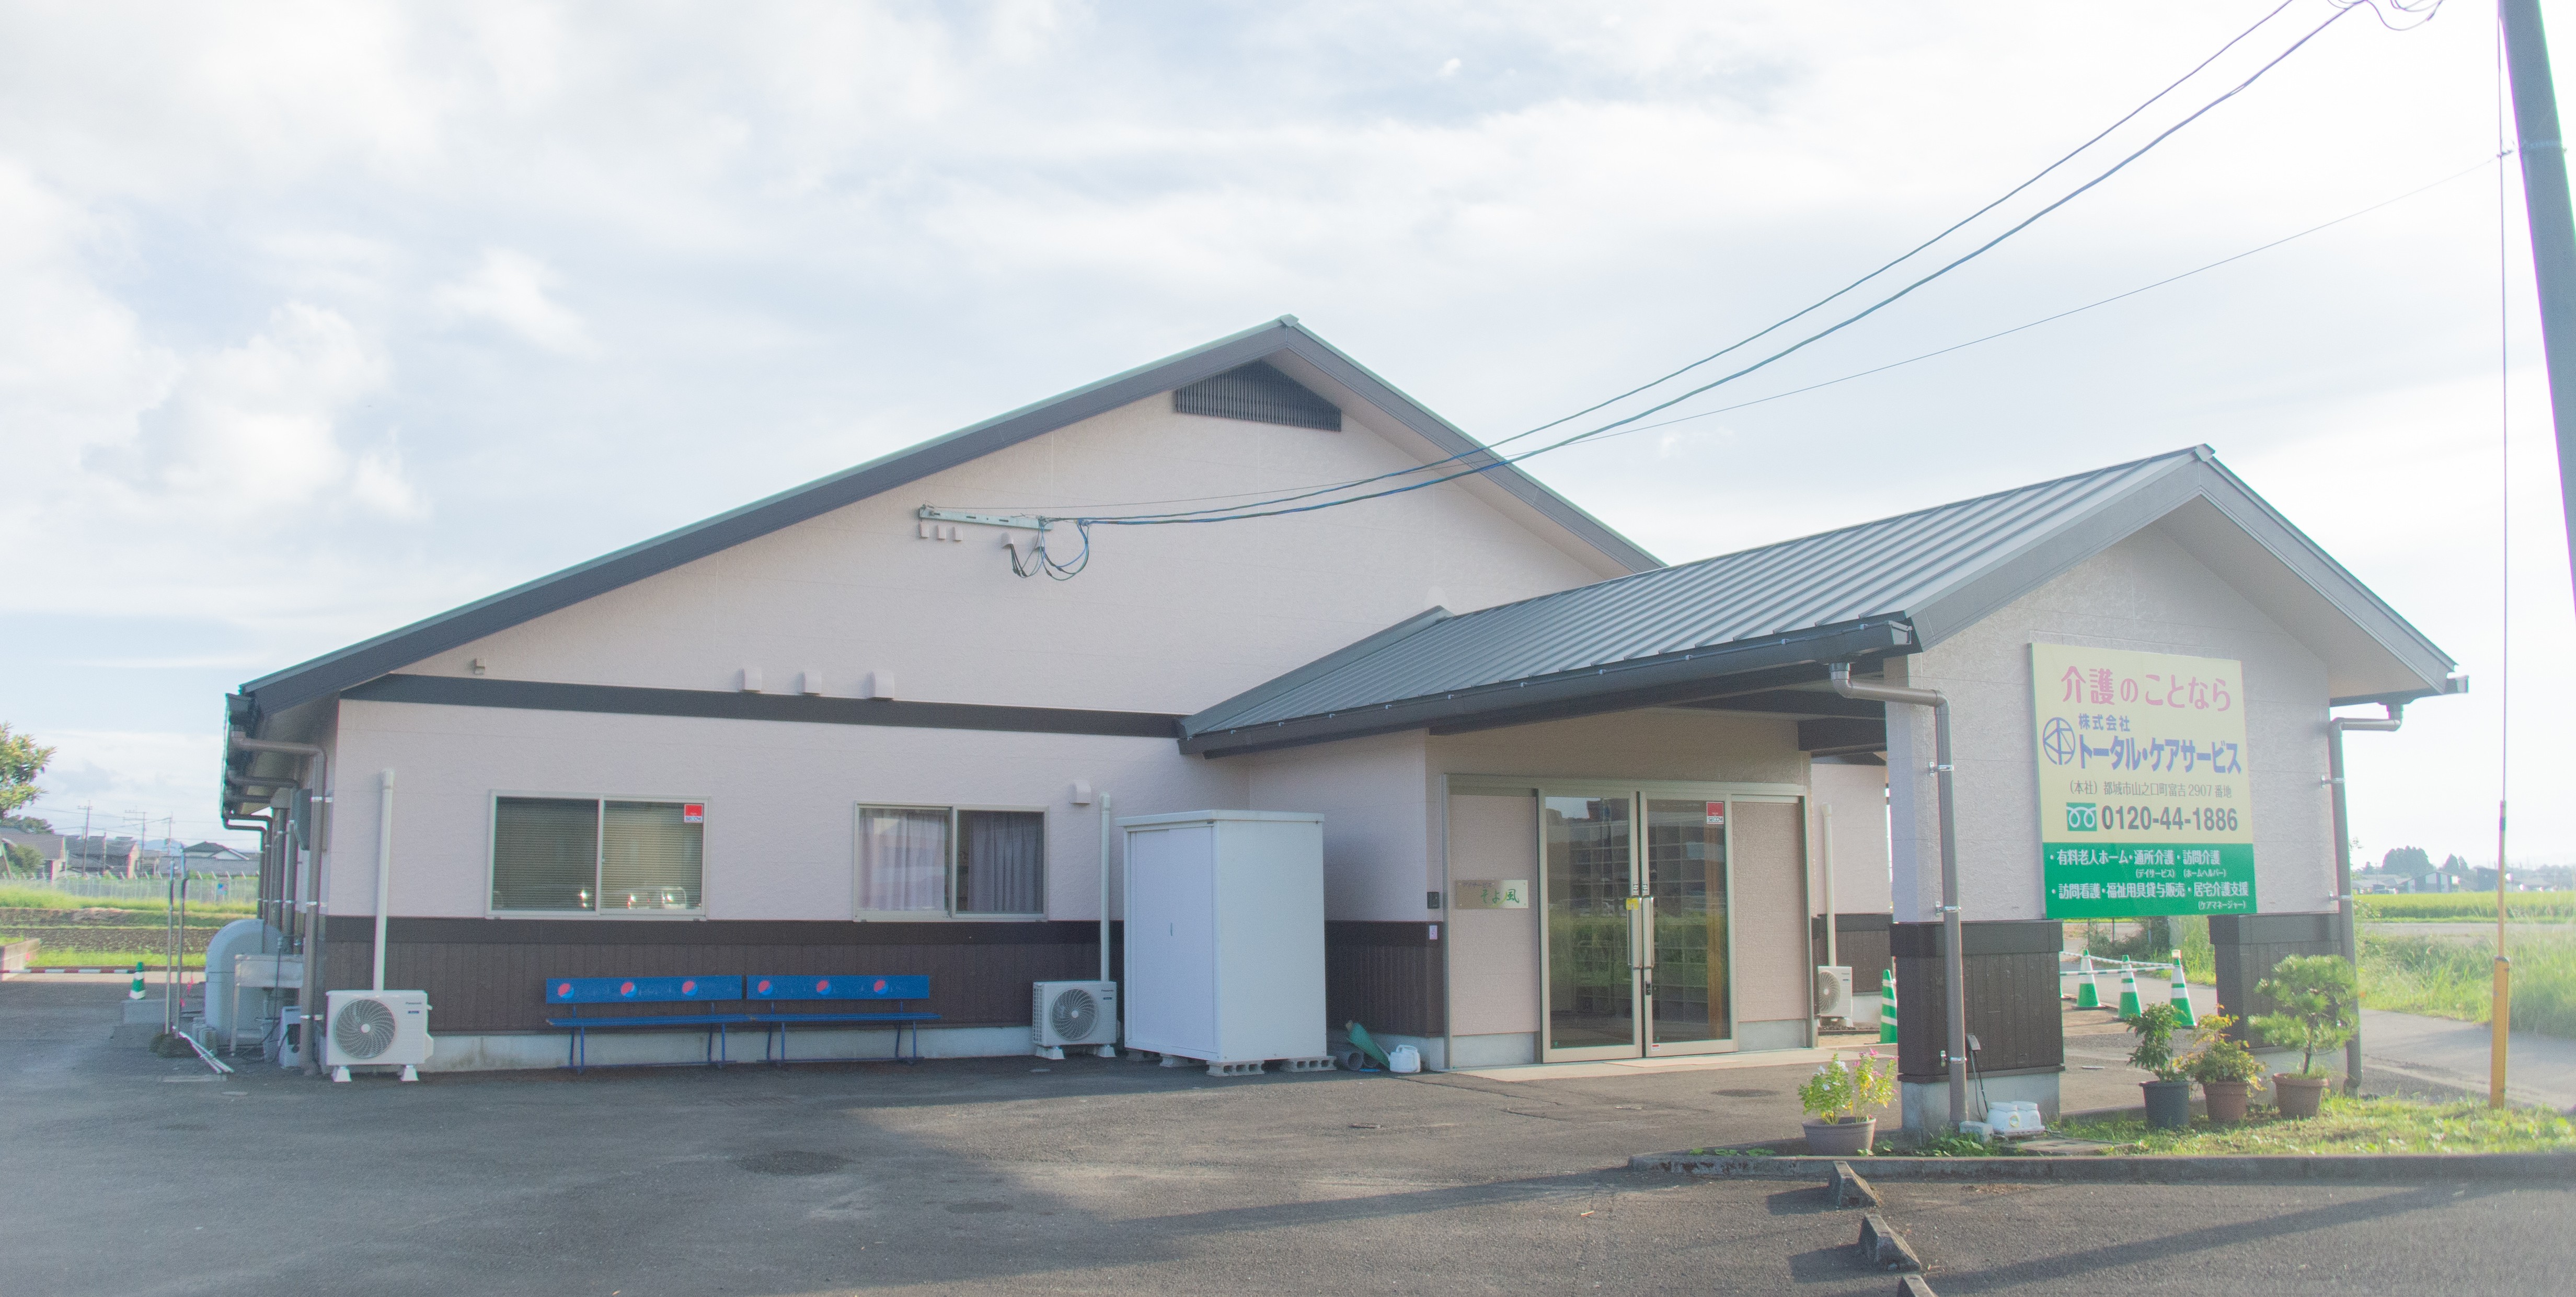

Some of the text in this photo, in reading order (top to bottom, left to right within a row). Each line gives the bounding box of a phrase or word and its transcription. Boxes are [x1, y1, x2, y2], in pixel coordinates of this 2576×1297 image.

[2061, 666, 2230, 712] 介護のことなら
[2079, 713, 2131, 732] 株式会社
[2079, 734, 2241, 774] トータル・ケアサービス
[2101, 805, 2238, 831] 0120-44-1886
[1480, 888, 1520, 904] そよ風
